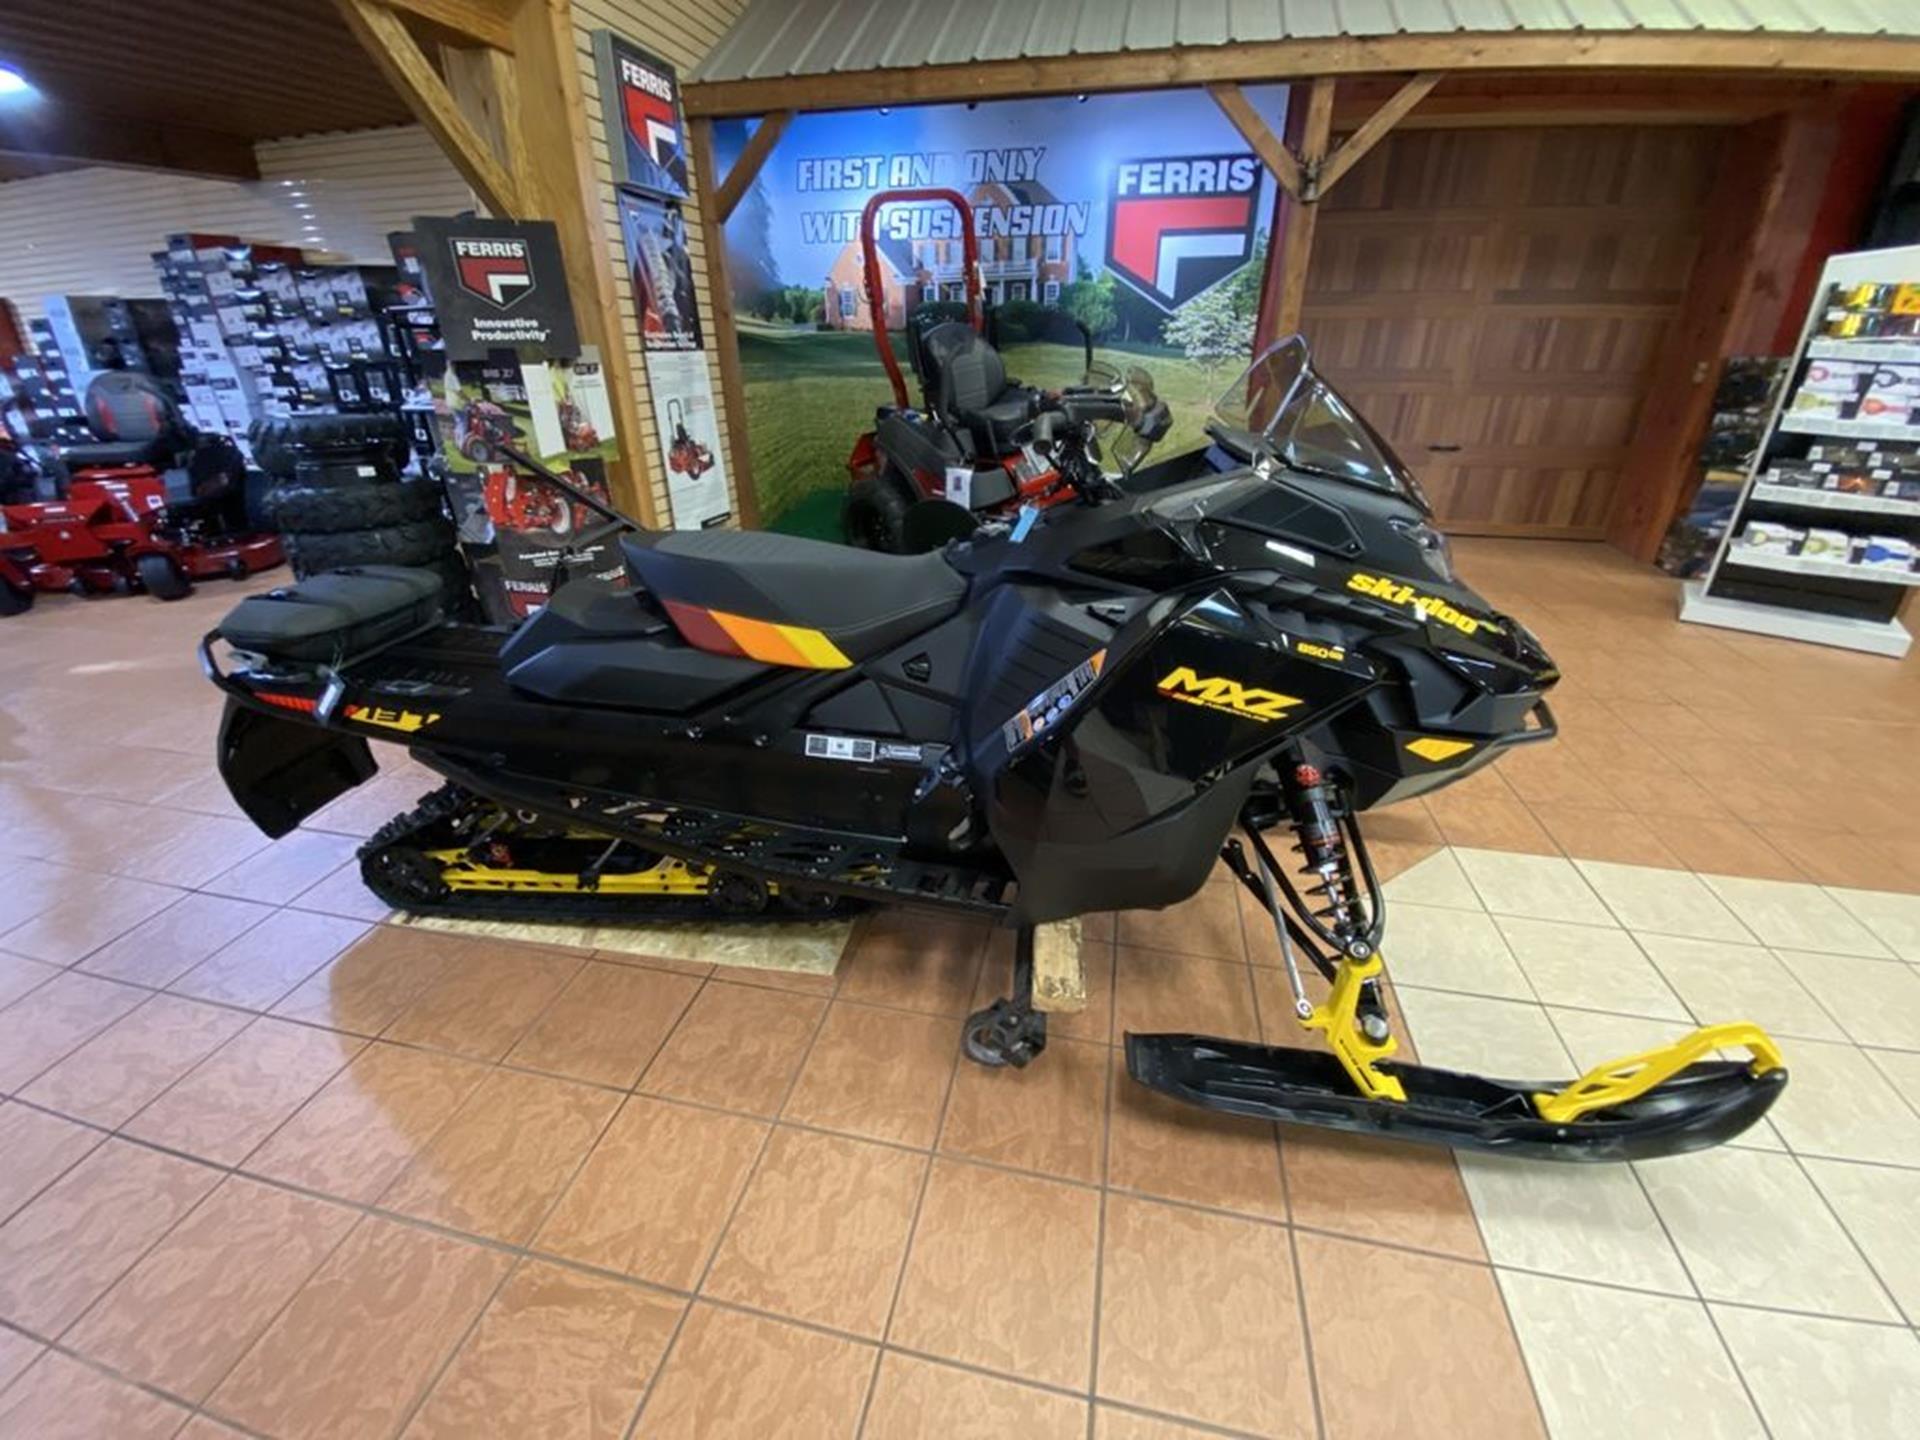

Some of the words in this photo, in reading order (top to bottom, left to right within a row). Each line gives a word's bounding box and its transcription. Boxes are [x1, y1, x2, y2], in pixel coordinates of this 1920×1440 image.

[620, 58, 672, 102] FERRIS
[796, 155, 885, 192] FIRST
[965, 147, 1048, 185] ONLY
[1117, 158, 1255, 196] FERRIS
[455, 241, 525, 258] FERRIS
[473, 317, 539, 329] Innovative
[504, 580, 549, 594] FERRIS
[1156, 665, 1305, 720] MXZ
